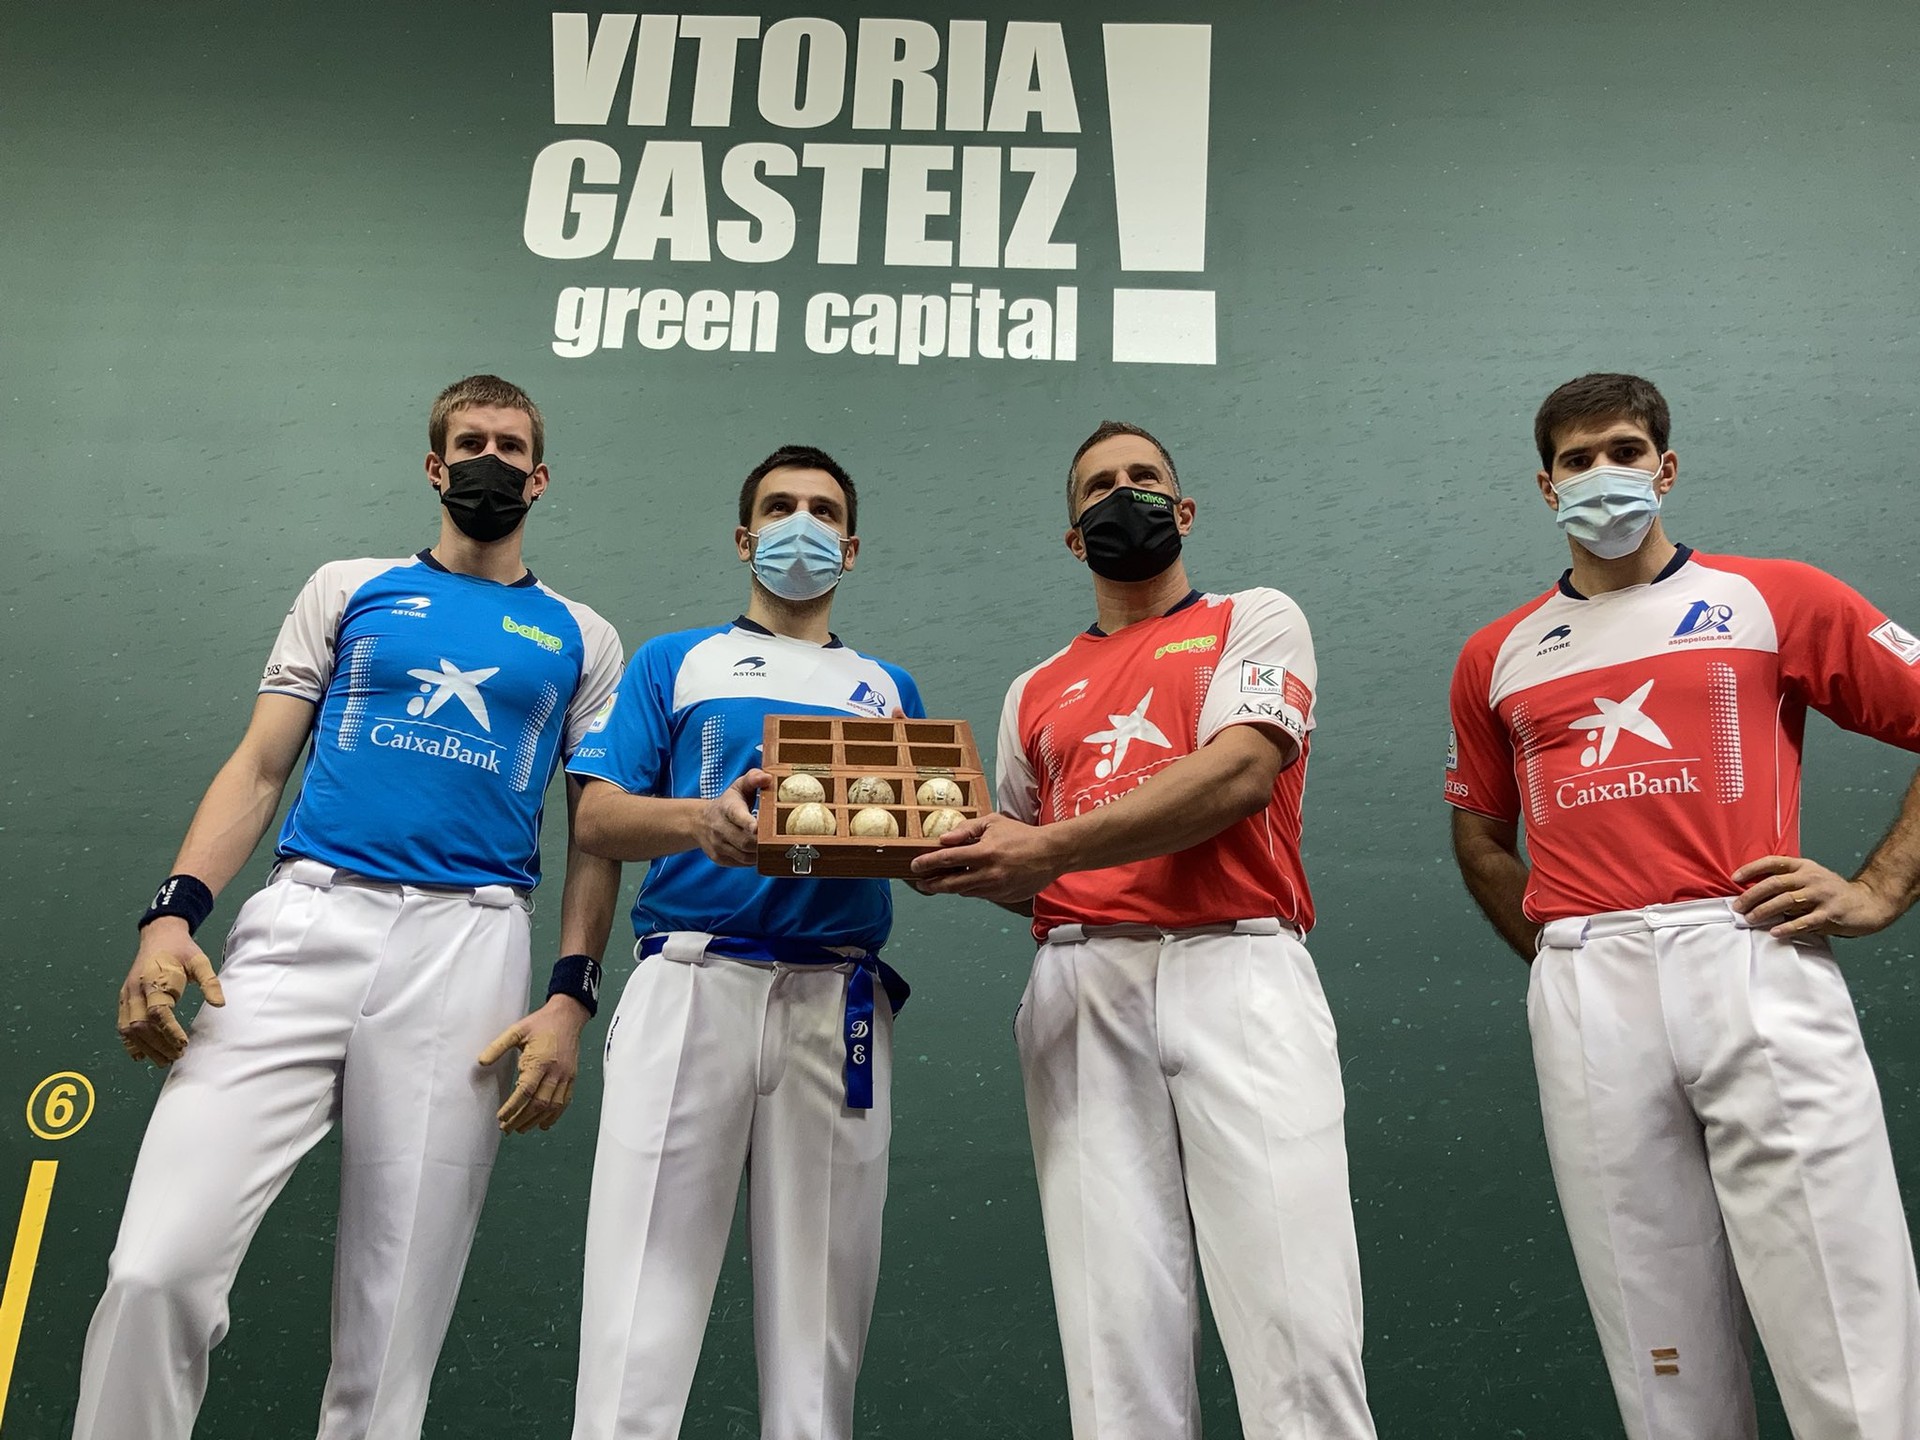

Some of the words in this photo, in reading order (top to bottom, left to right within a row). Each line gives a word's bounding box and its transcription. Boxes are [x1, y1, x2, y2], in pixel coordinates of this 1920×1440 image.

[552, 12, 1082, 134] VITORIA
[523, 139, 1077, 270] GASTEIZ
[551, 285, 780, 358] green
[804, 283, 1078, 365] capital
[391, 609, 427, 618] ASTORE
[1536, 641, 1571, 657] ASTORE
[1668, 634, 1733, 645] aspepelota.eus
[370, 723, 501, 775] CaixaBank
[1556, 767, 1701, 809] CaixaBank
[582, 960, 594, 992] ASTORE
[850, 1020, 869, 1039] D
[45, 1083, 77, 1128] 6
